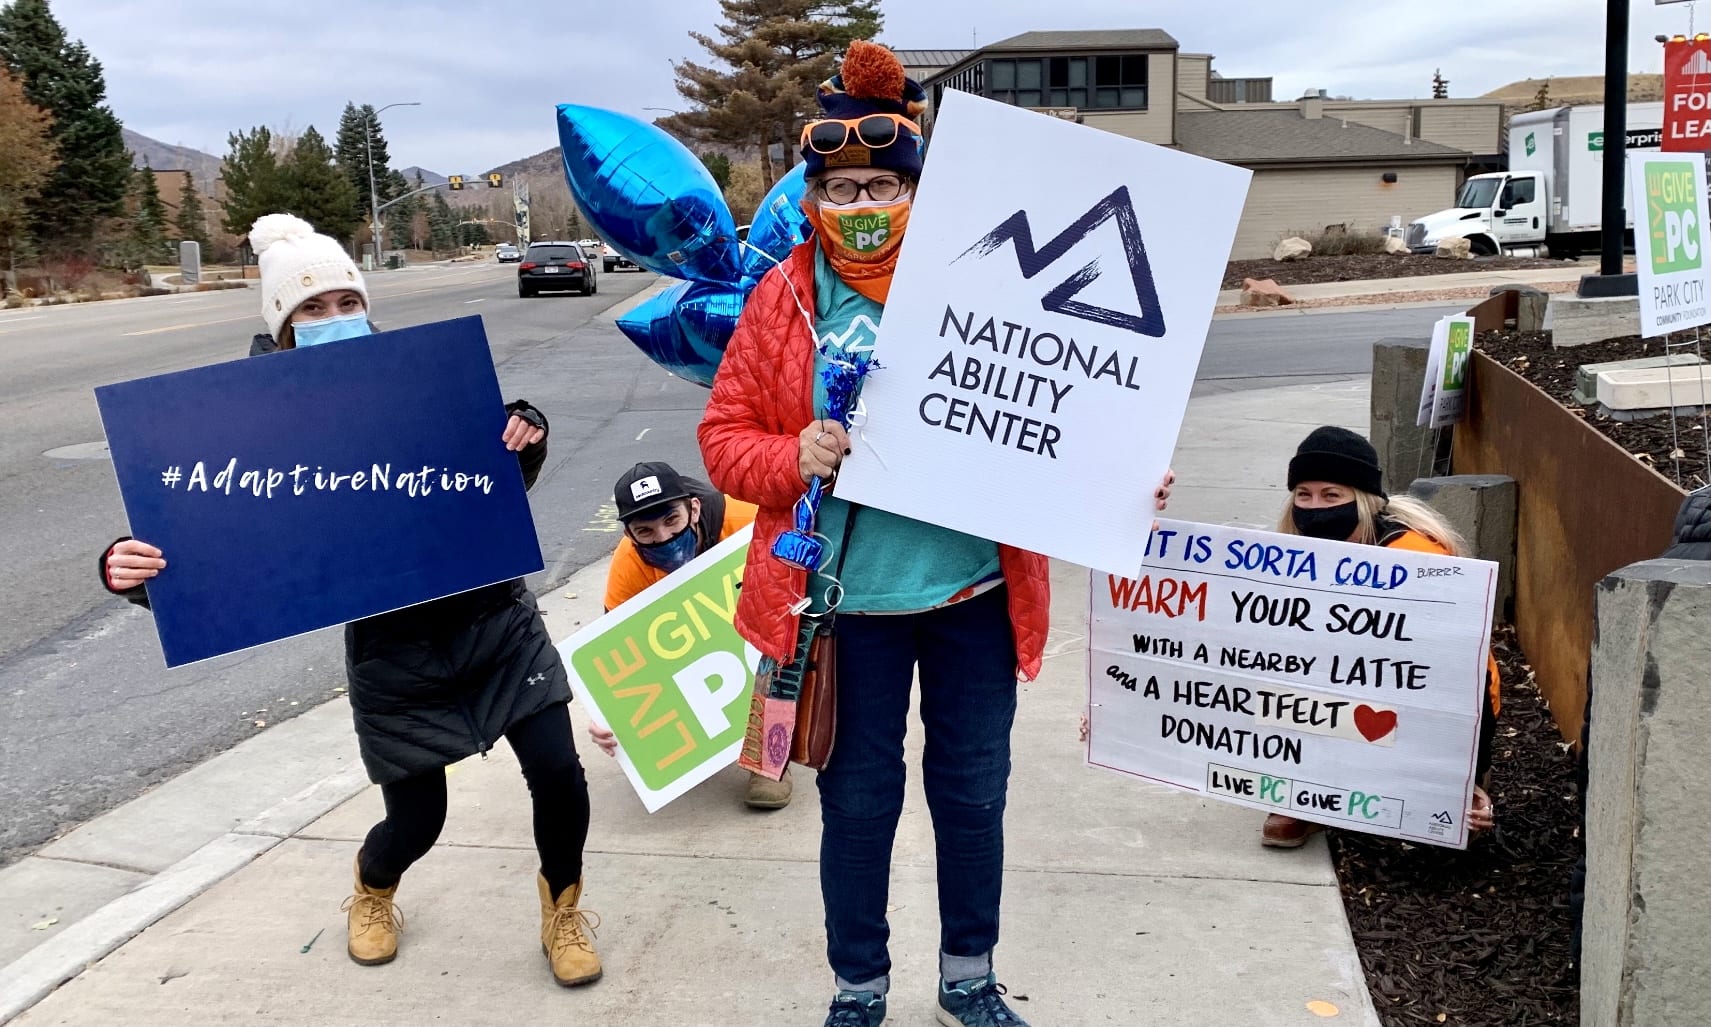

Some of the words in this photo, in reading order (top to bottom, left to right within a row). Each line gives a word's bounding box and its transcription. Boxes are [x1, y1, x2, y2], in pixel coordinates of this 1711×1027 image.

[1662, 170, 1696, 205] GIVE
[854, 214, 888, 231] GIVE
[856, 228, 888, 250] PC
[1649, 172, 1667, 265] LIVE
[1665, 208, 1699, 264] PC
[1654, 284, 1681, 310] PARK
[1683, 279, 1705, 305] CITY
[939, 304, 1141, 391] NATIONAL
[928, 351, 1074, 415] ABILITY
[919, 392, 1062, 460] CENTER
[161, 457, 494, 499] #AdaptiveNation
[1144, 529, 1178, 558] IT
[1184, 534, 1212, 564] IS
[1224, 539, 1317, 582] SORTA
[1334, 556, 1408, 590] COLD
[647, 564, 746, 660] GIV
[1107, 573, 1208, 622] WARM
[1231, 590, 1314, 632] YOUR
[1325, 602, 1413, 643] SOUL
[672, 640, 763, 740] P
[1132, 633, 1183, 659] WITH
[1194, 642, 1209, 664] A
[1220, 646, 1317, 676] NEARBY
[1330, 655, 1432, 691] LATTE
[593, 636, 698, 771] LIVE
[1106, 665, 1137, 692] and
[1143, 675, 1161, 701] A
[1174, 680, 1350, 729] HEARTFELT
[1161, 713, 1303, 765] DONATION
[1212, 770, 1255, 796] LIVE
[1259, 774, 1286, 804] PC
[1296, 789, 1343, 813] GIVE
[1348, 790, 1383, 821] PC
